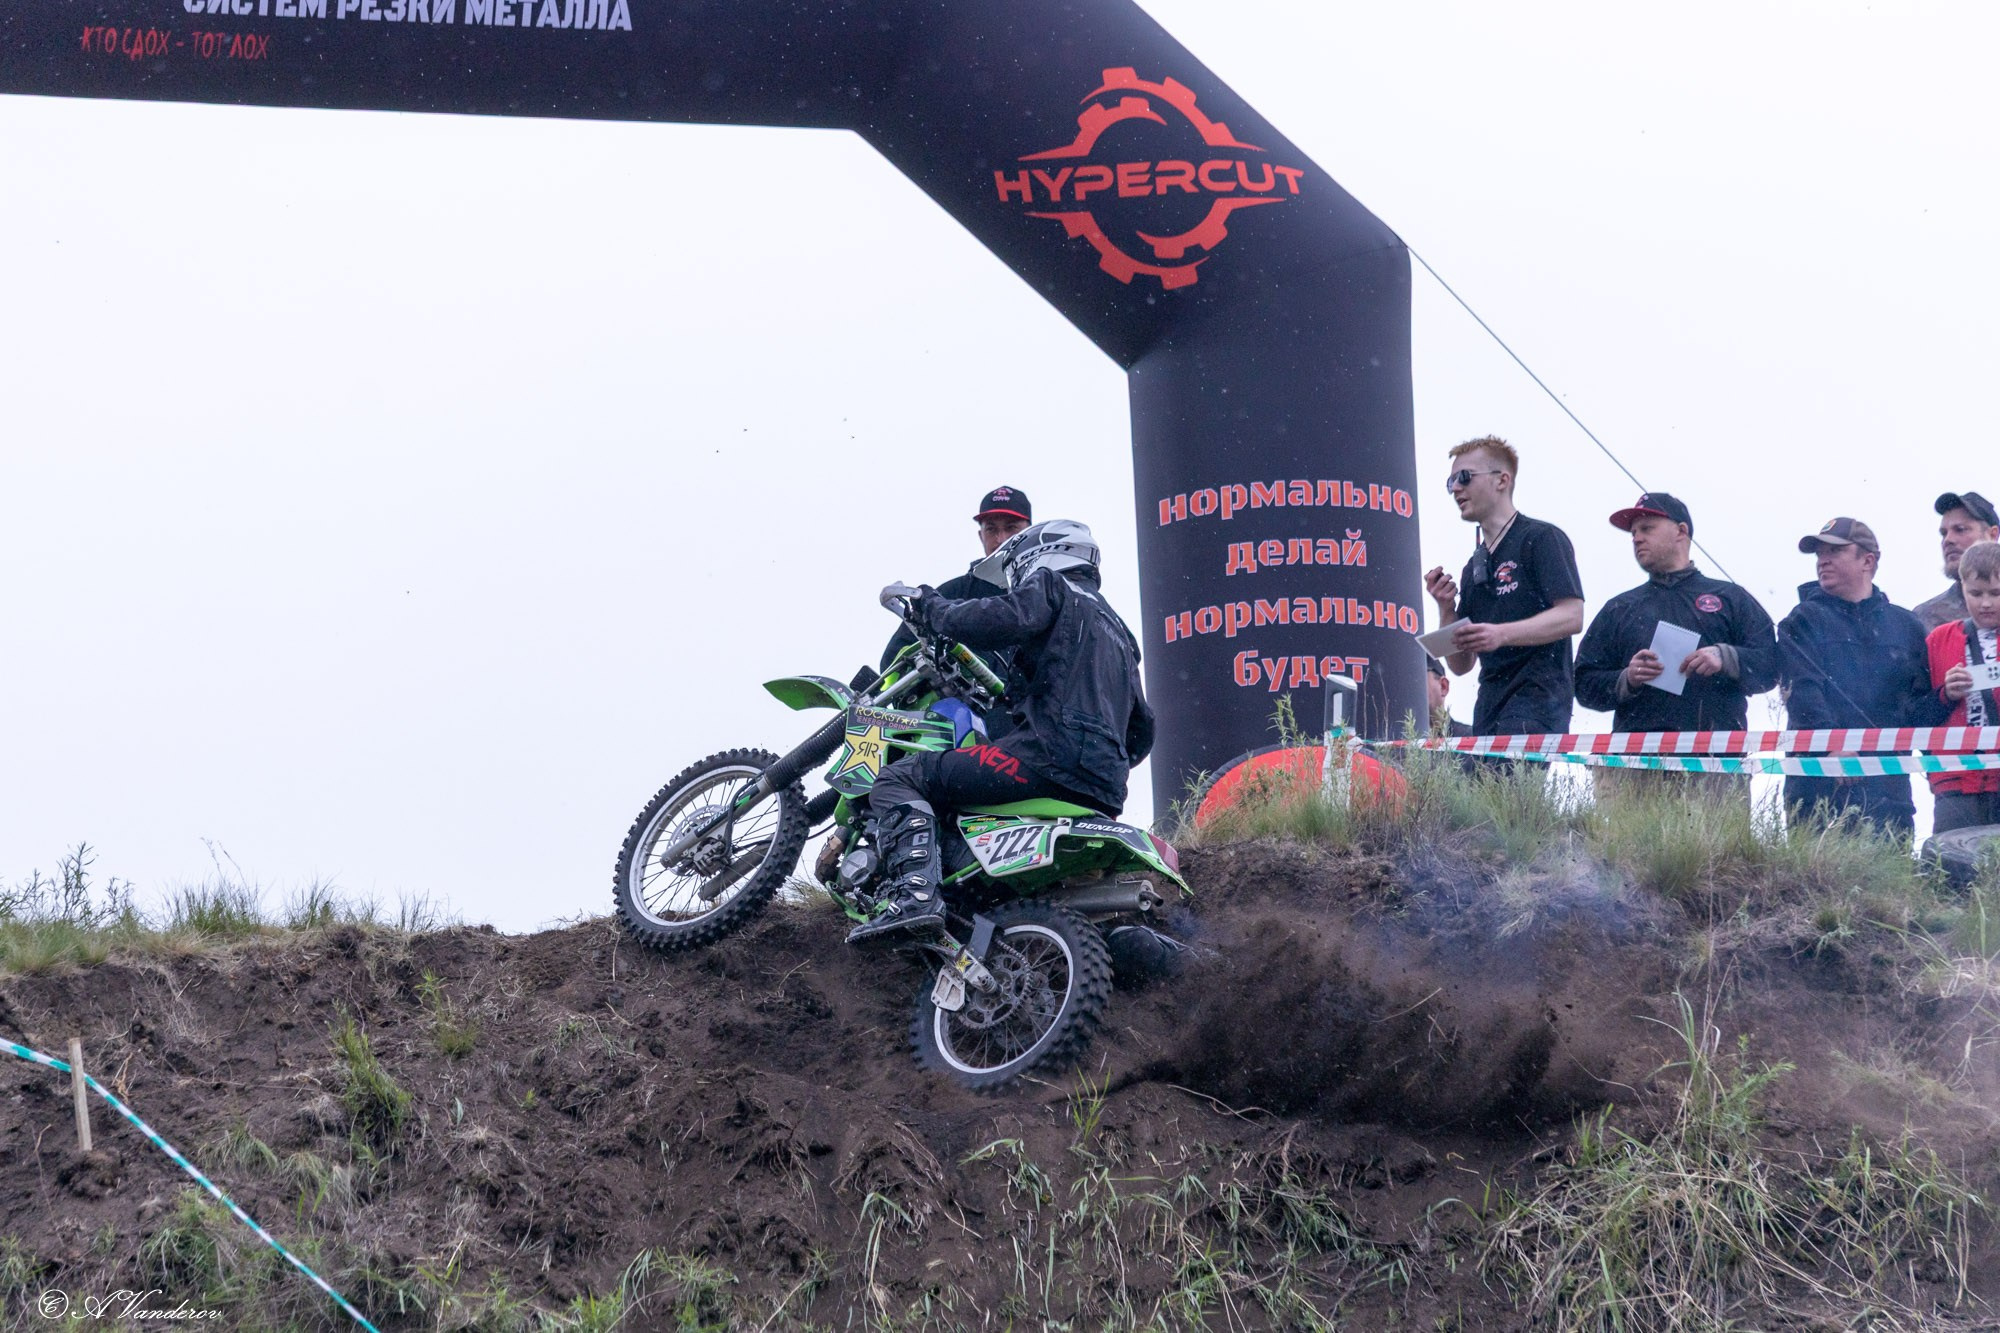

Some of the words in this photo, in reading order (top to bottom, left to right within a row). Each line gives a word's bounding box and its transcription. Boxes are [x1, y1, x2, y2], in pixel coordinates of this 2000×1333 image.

[336, 0, 455, 24] РЕЗКИ
[464, 0, 633, 31] МЕТАЛЛА
[82, 25, 118, 53] КТО
[192, 31, 225, 59] ТОТ
[229, 32, 271, 60] ЛОХ
[994, 159, 1305, 203] HYPERCUT
[1158, 479, 1414, 527] нормально
[1020, 544, 1074, 562] SCOTT
[1225, 527, 1367, 576] делай
[1164, 596, 1420, 644] нормально
[1233, 649, 1370, 693] будет
[857, 715, 887, 728] ENERGY
[988, 825, 1046, 866] 222
[1075, 822, 1134, 834] DUNLOP
